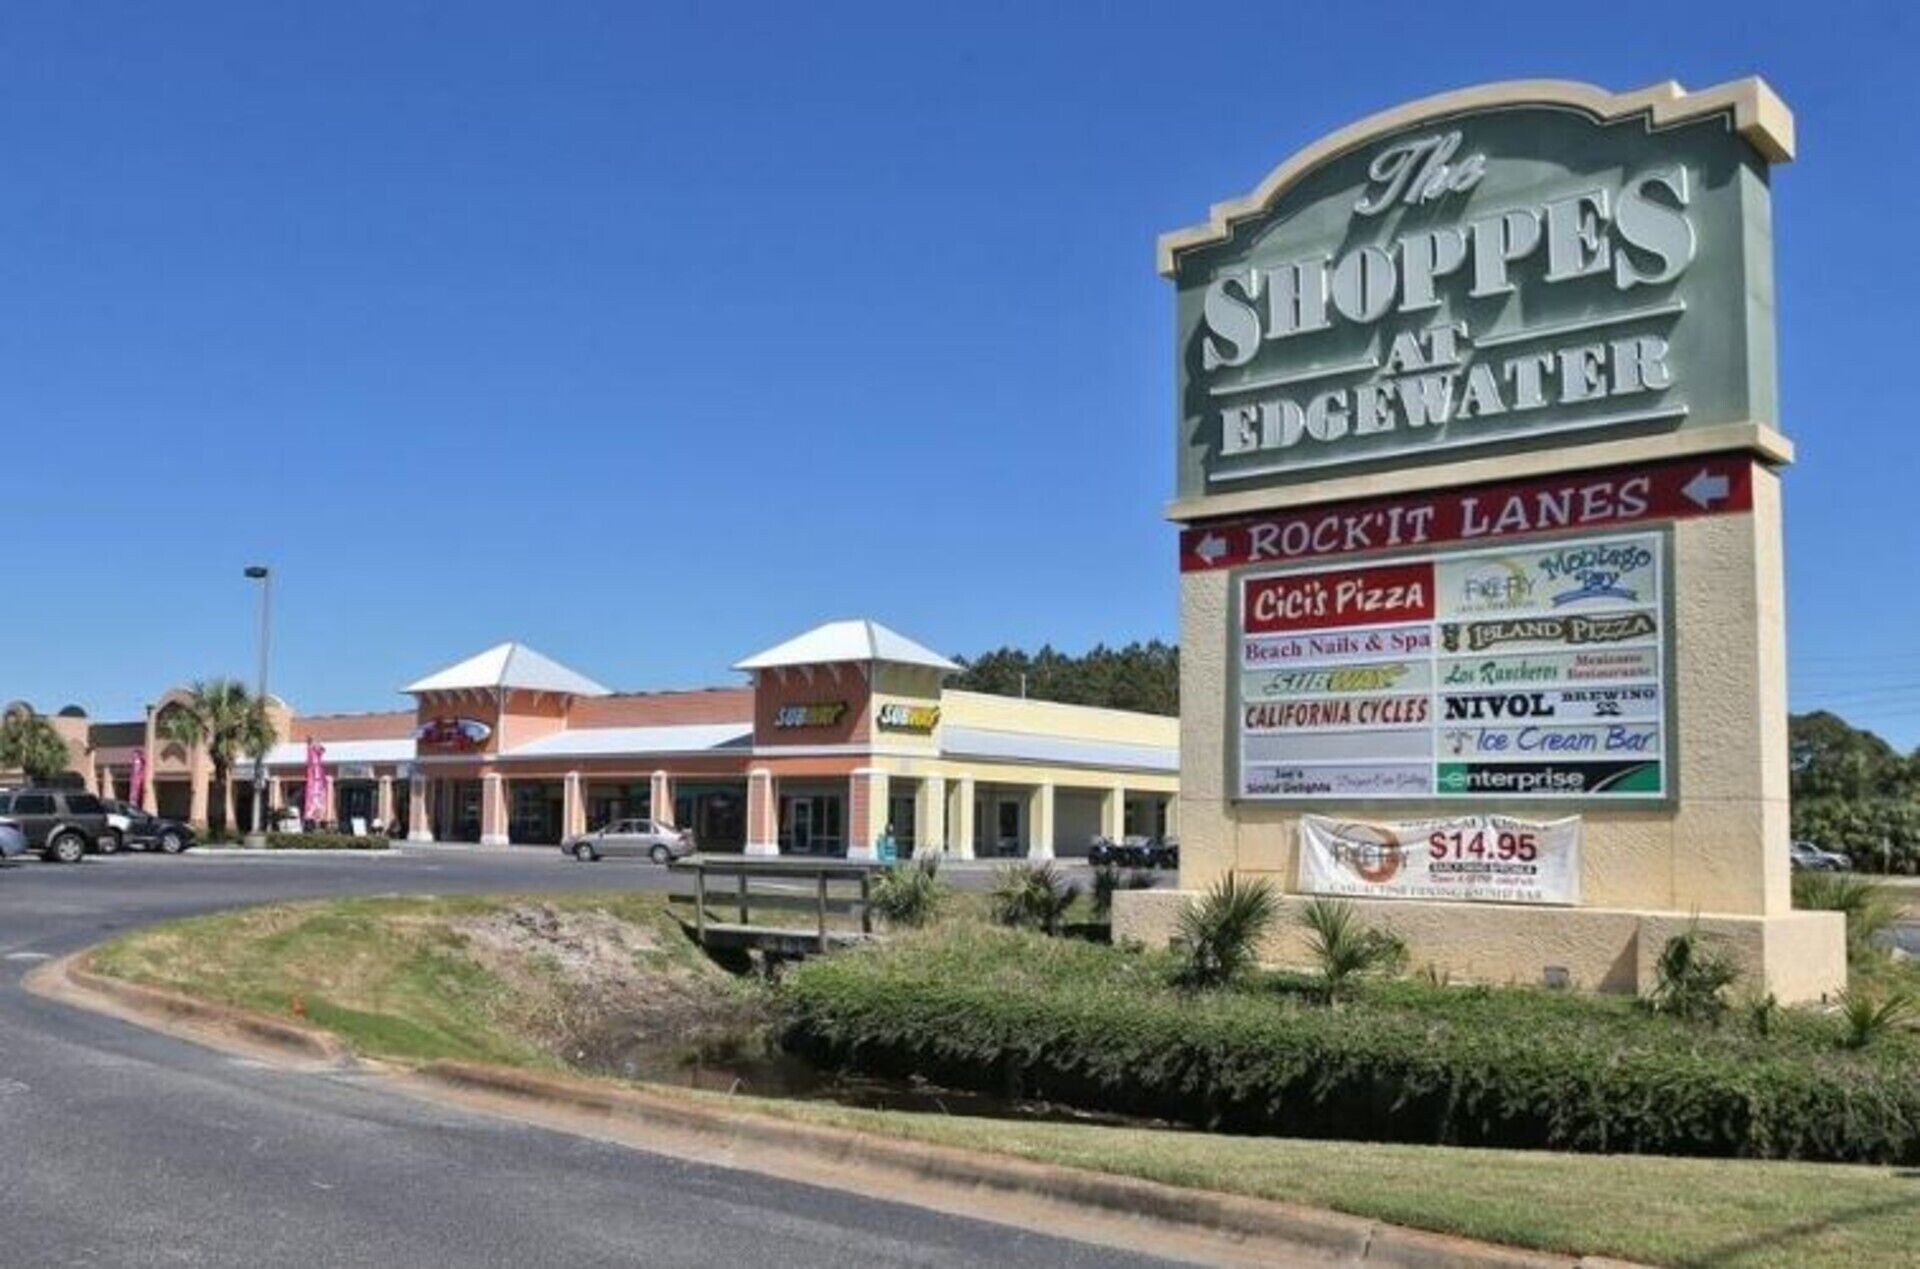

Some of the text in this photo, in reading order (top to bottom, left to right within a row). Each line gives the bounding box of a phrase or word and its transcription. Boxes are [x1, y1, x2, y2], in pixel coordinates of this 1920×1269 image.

[1354, 130, 1486, 215] The
[1204, 163, 1697, 371] SHOPPES
[1383, 321, 1469, 375] AT
[1219, 334, 1673, 455] EDGEWATER
[1248, 476, 1651, 562] ROCK'IT LANES
[1539, 545, 1651, 581] Montego
[1245, 631, 1430, 660] Beach Nails & Spa
[1475, 615, 1650, 646] ISLAND PIZZA
[1444, 663, 1475, 685] Los
[1444, 693, 1555, 719] NIVOL
[1562, 688, 1656, 703] BREWING
[1245, 698, 1428, 729] CALIFORNIA CYCLES
[1477, 724, 1656, 752] Ice Cream Bar
[1446, 768, 1585, 791] enterprise
[1429, 831, 1538, 862] $14.95
